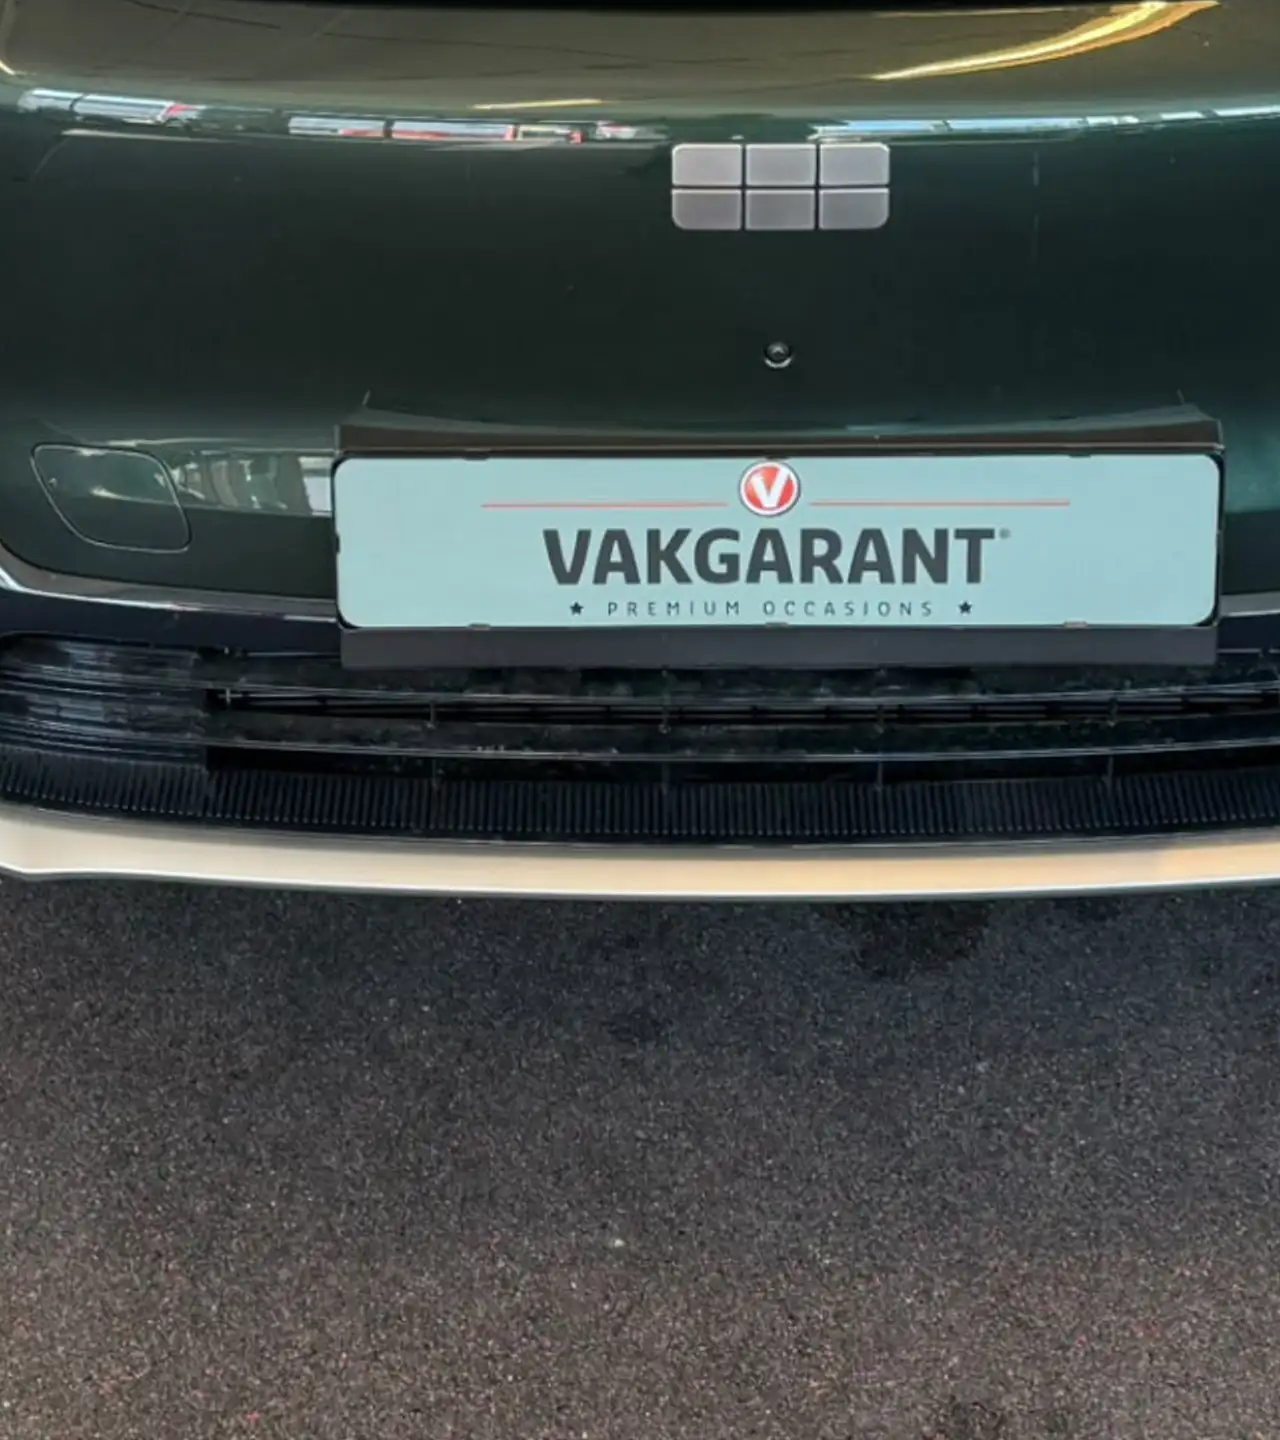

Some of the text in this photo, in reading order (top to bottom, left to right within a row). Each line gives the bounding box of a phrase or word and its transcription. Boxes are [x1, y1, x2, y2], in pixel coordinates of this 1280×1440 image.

[542, 527, 996, 585] VAKGARANT
[607, 600, 740, 616] PREMIUM
[763, 600, 933, 617] OCCASIONS
